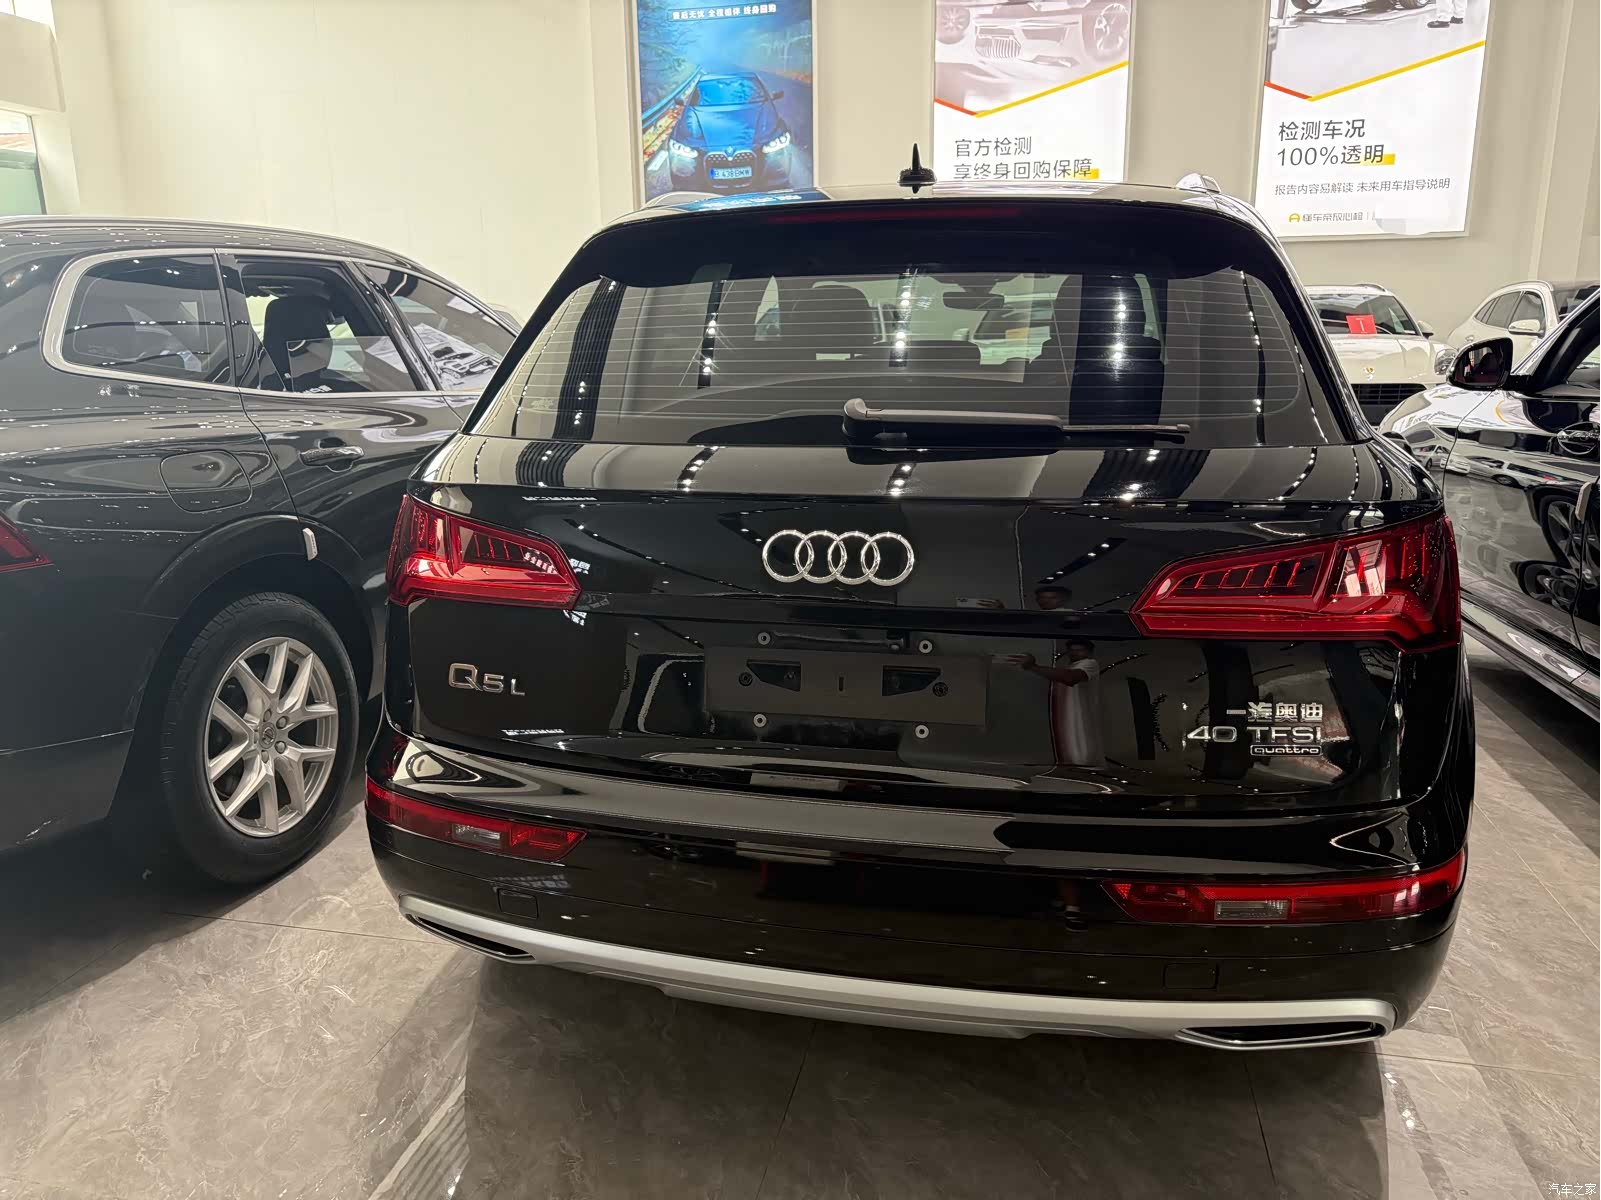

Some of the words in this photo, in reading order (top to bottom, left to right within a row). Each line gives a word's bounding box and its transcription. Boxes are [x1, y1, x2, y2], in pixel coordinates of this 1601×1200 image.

[1278, 118, 1366, 142] 检测车况
[954, 136, 1032, 158] 官方检测
[1277, 144, 1385, 167] 100%透明
[953, 158, 1093, 180] 享终身回购保障
[1274, 181, 1354, 196] 报告内容易解读
[1356, 178, 1451, 194] 未来用车指导说明
[1226, 701, 1323, 722] 一汽奥迪
[1187, 725, 1238, 743] 40
[1253, 744, 1320, 757] quattro
